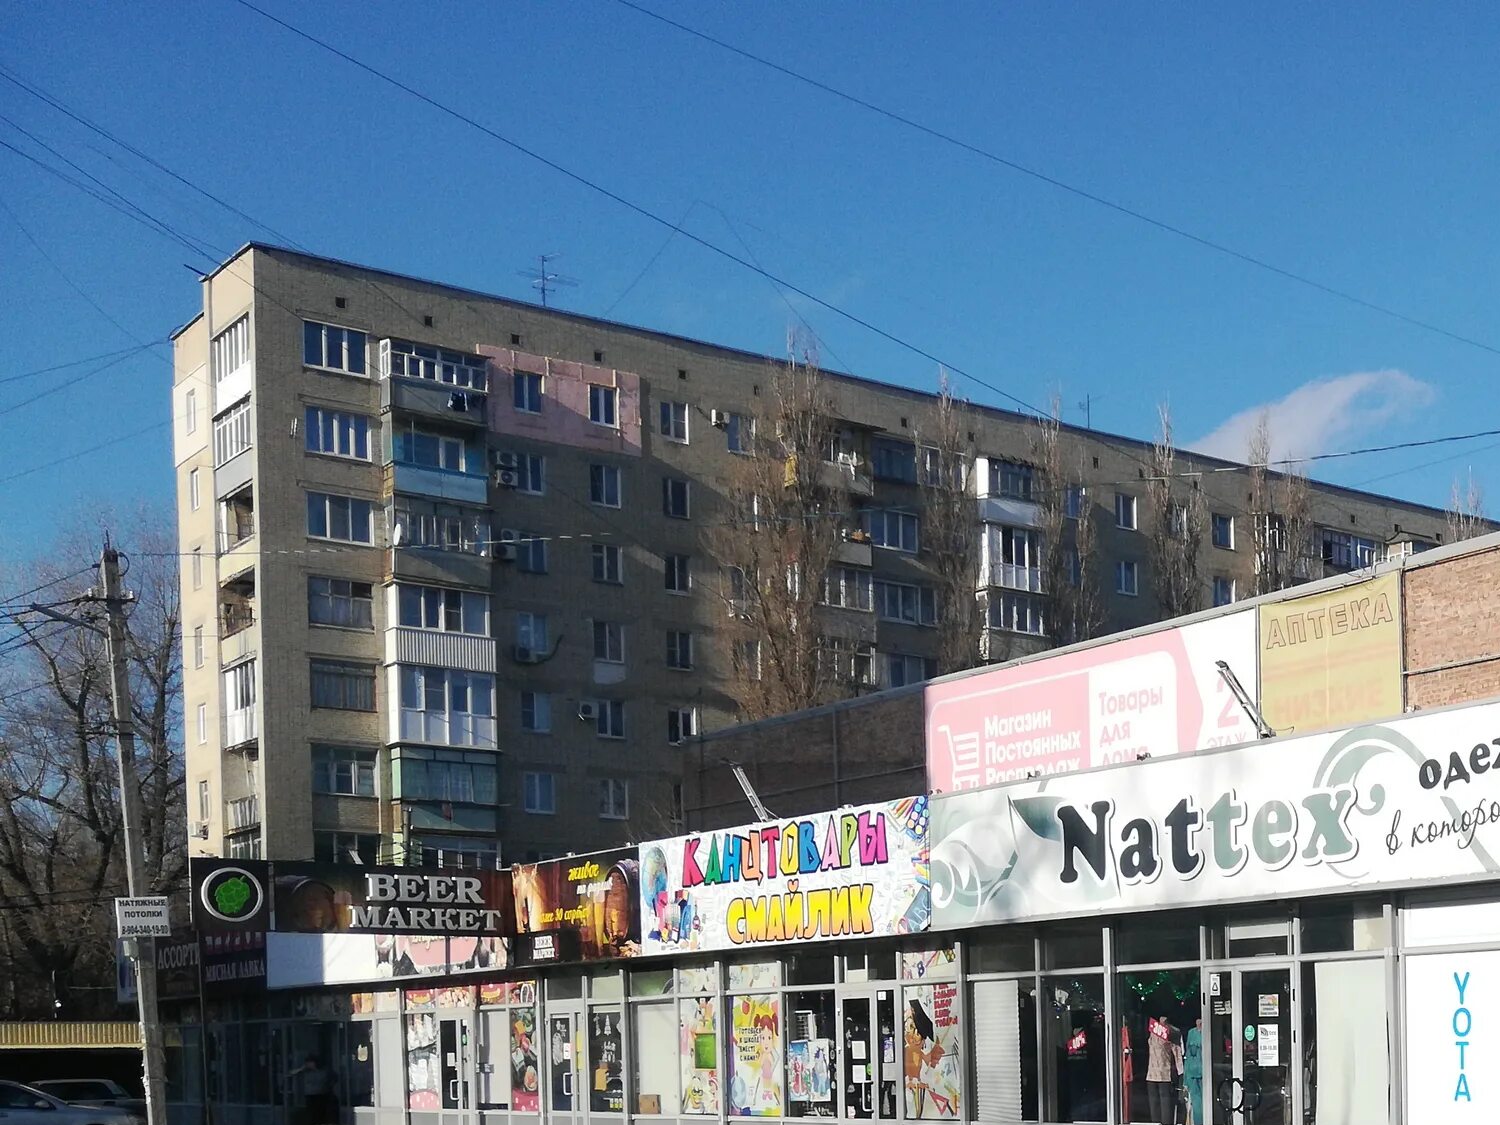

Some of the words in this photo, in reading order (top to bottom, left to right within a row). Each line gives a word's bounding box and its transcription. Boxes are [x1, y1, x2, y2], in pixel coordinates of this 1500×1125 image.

[1266, 593, 1393, 650] АПТЕКА
[1098, 686, 1163, 717] Товары
[1216, 672, 1241, 731] 2
[984, 709, 1052, 740] Магазин
[1099, 721, 1132, 748] для
[984, 731, 1082, 760] Постоянных
[682, 809, 889, 888] КАНЦТОВАРЫ
[1056, 781, 1367, 886] Nattex
[1386, 817, 1403, 856] в
[568, 861, 600, 881] живое
[118, 899, 166, 907] НАТЯЖНЫЕ
[365, 873, 486, 904] BEER
[349, 905, 501, 931] MARKET
[726, 878, 875, 945] СМАЙЛИК
[1452, 971, 1471, 1103] YOTA
